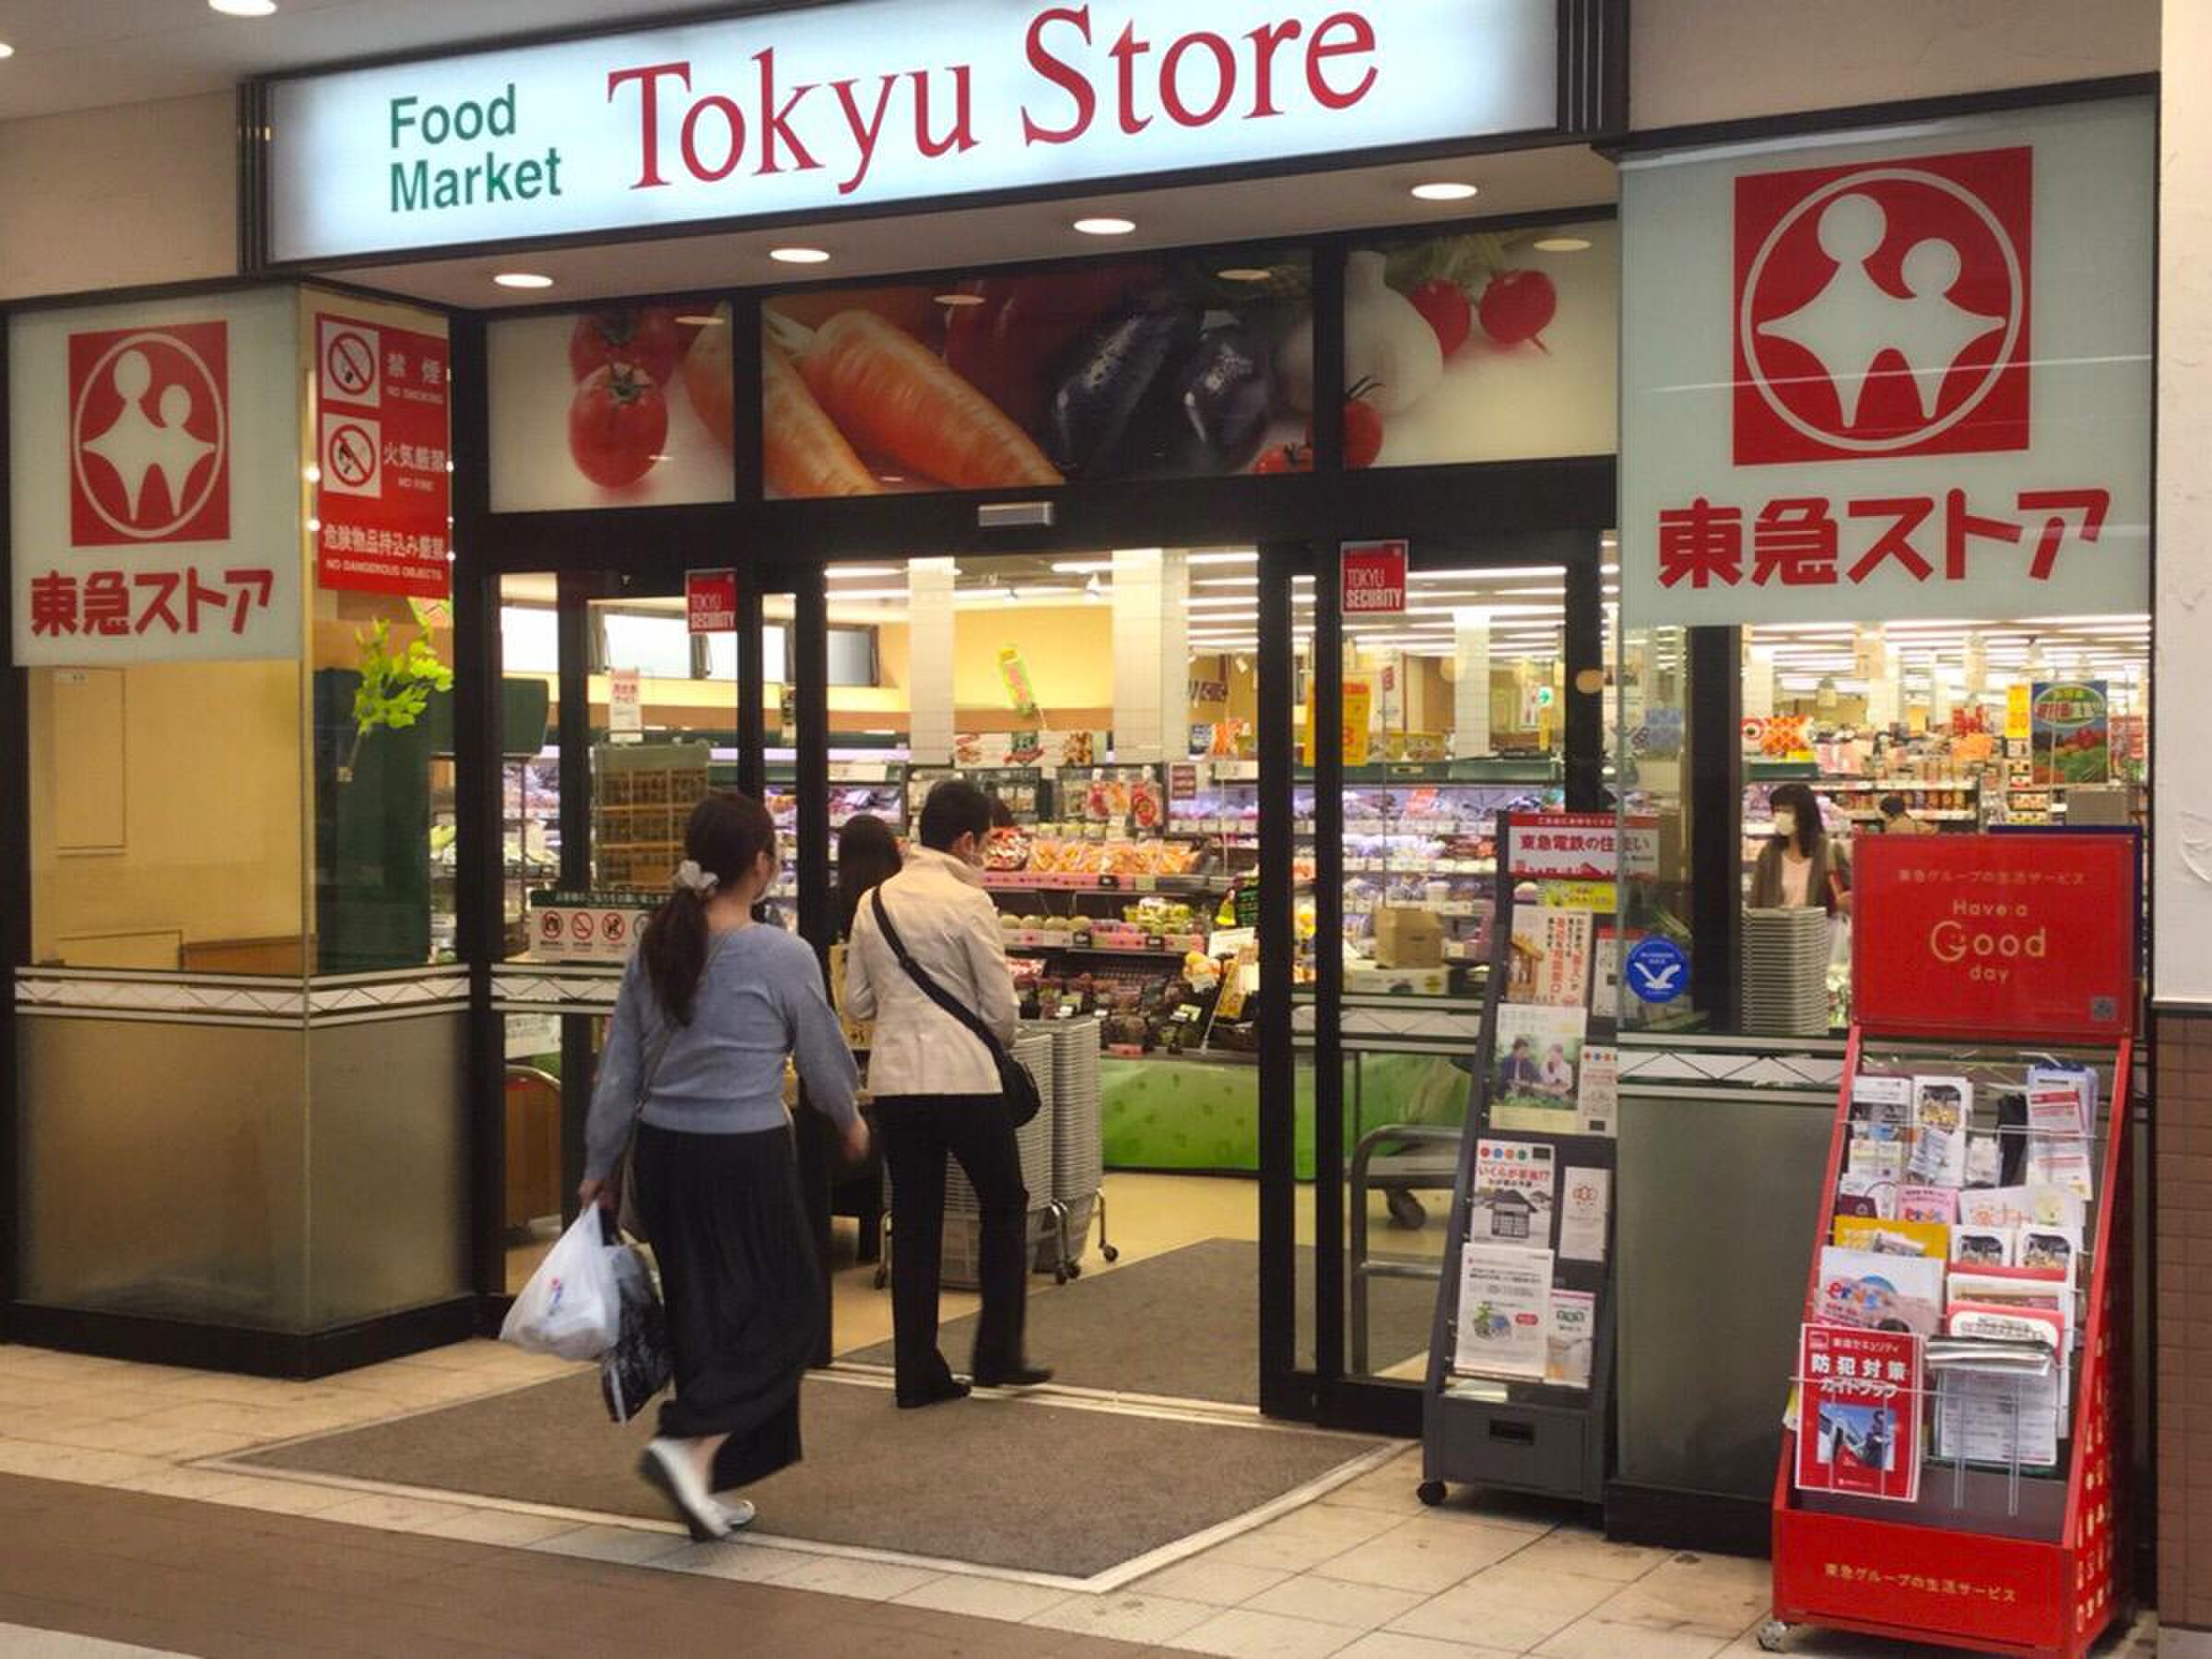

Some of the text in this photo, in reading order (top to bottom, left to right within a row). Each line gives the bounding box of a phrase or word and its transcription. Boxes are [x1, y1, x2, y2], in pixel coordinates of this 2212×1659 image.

[390, 83, 516, 147] Food
[606, 4, 1378, 195] Tokyu Store
[391, 147, 561, 212] Market
[1657, 488, 2111, 589] 東急ストア
[1347, 568, 1385, 588] TOKYU
[1347, 589, 1402, 608] SECURITY
[30, 568, 274, 636] 東急ストア
[1952, 900, 2007, 915] Have
[1930, 920, 2046, 961] Good
[1970, 968, 2009, 984] day
[1810, 1354, 1907, 1381] 防犯対策
